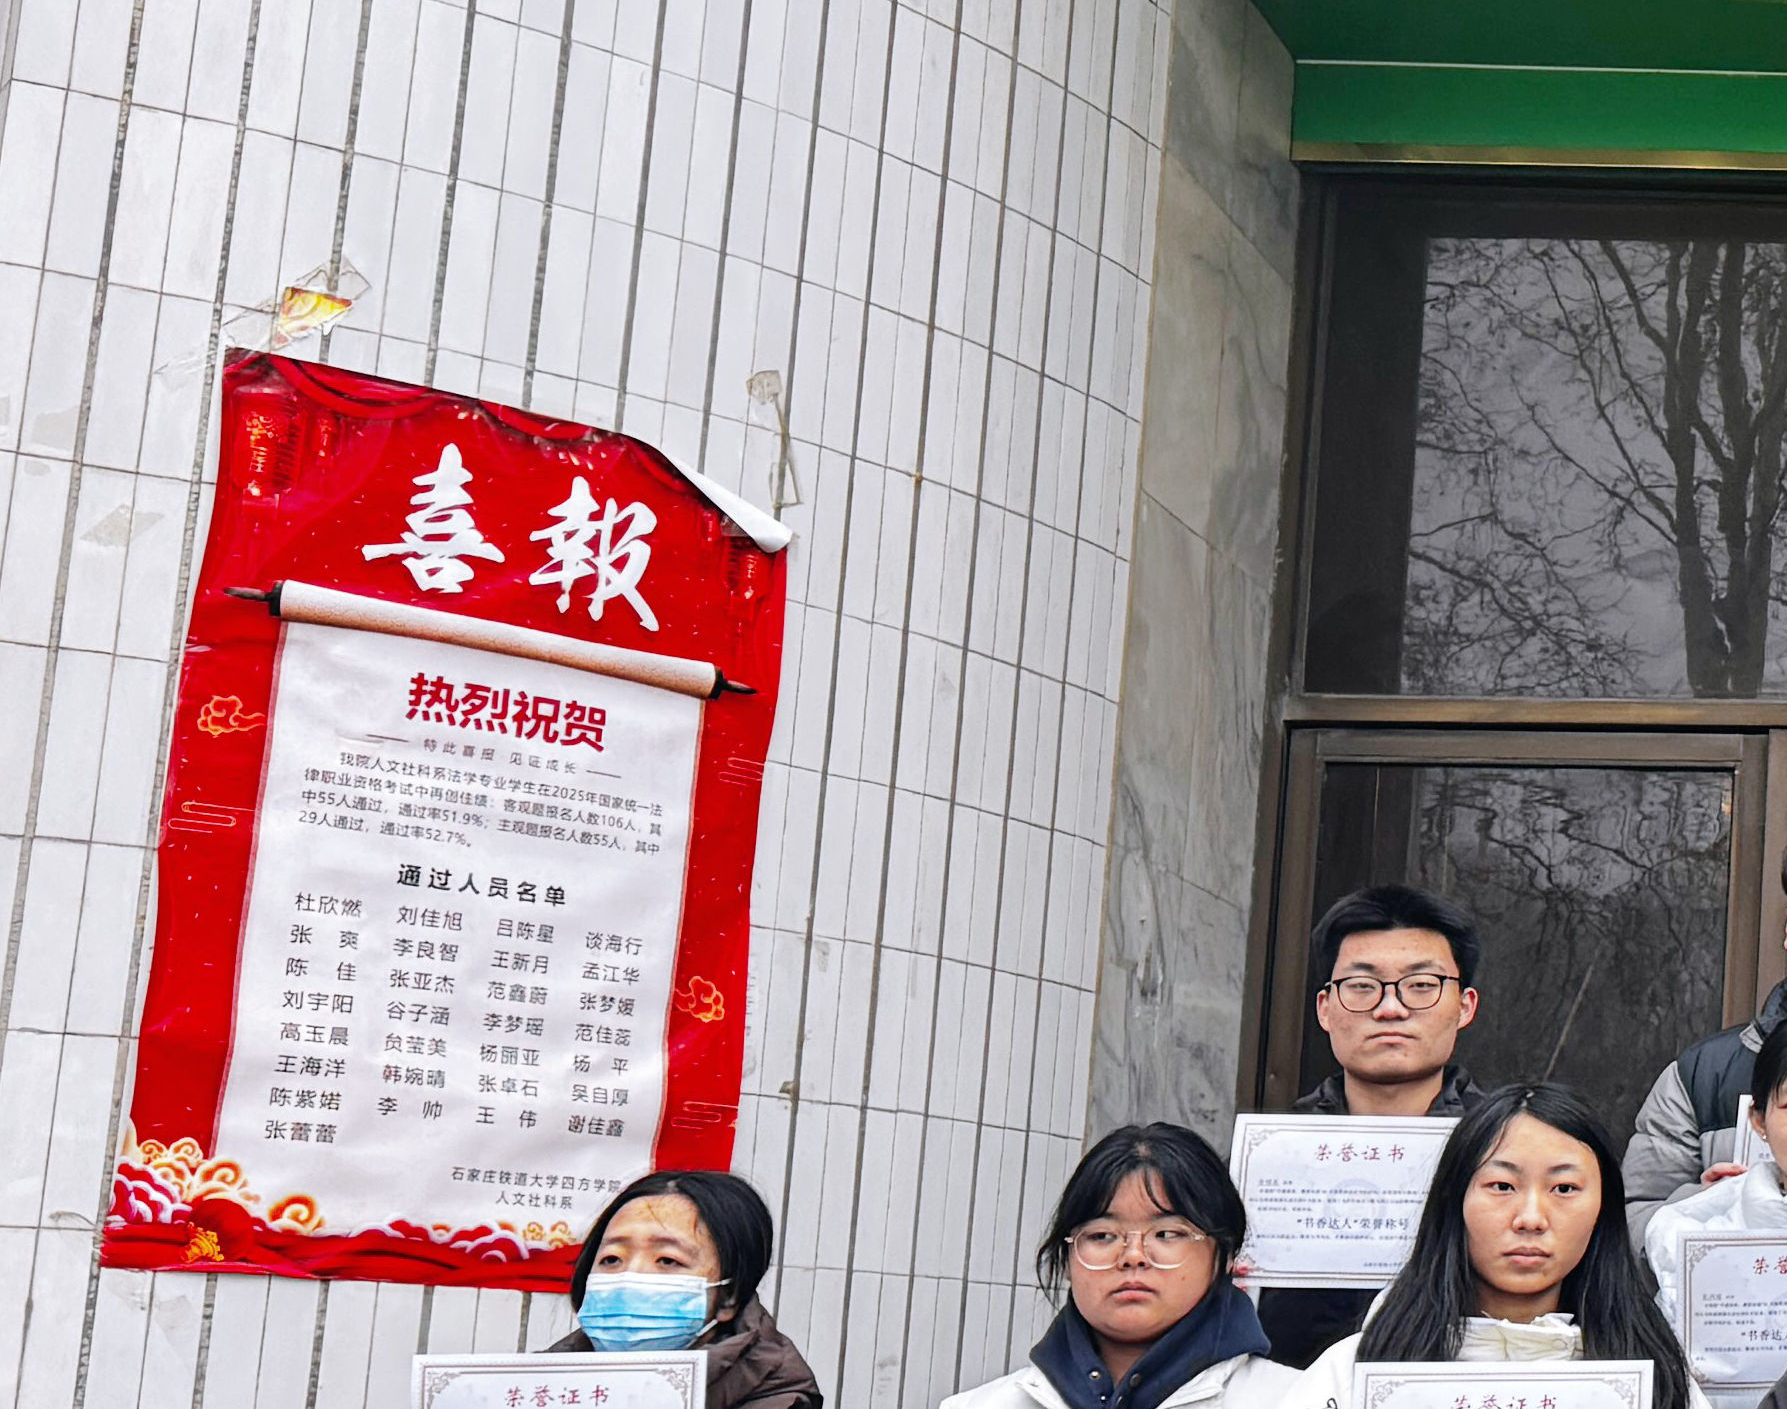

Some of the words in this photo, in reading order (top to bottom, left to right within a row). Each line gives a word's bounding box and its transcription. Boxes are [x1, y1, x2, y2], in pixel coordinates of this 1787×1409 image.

[362, 442, 660, 632] 喜報
[405, 672, 606, 752] 热烈祝贺
[397, 863, 566, 906] 通过人员名单
[397, 906, 463, 932] 刘佳旭
[393, 938, 459, 963] 李良智
[491, 950, 549, 974] 王新月
[582, 962, 640, 985] 孟江华
[389, 969, 456, 994] 张亚杰
[282, 990, 354, 1014] 刘宇阳
[387, 1001, 450, 1026] 谷子涵
[280, 1022, 349, 1047] 高玉晨
[480, 1044, 541, 1067] 杨丽亚
[274, 1054, 346, 1079] 王海洋
[478, 1075, 539, 1098] 张卓石
[1314, 1144, 1405, 1163] 荣誉证书
[496, 1191, 573, 1210] 人文社科系
[505, 1385, 610, 1408] 荣誉证书
